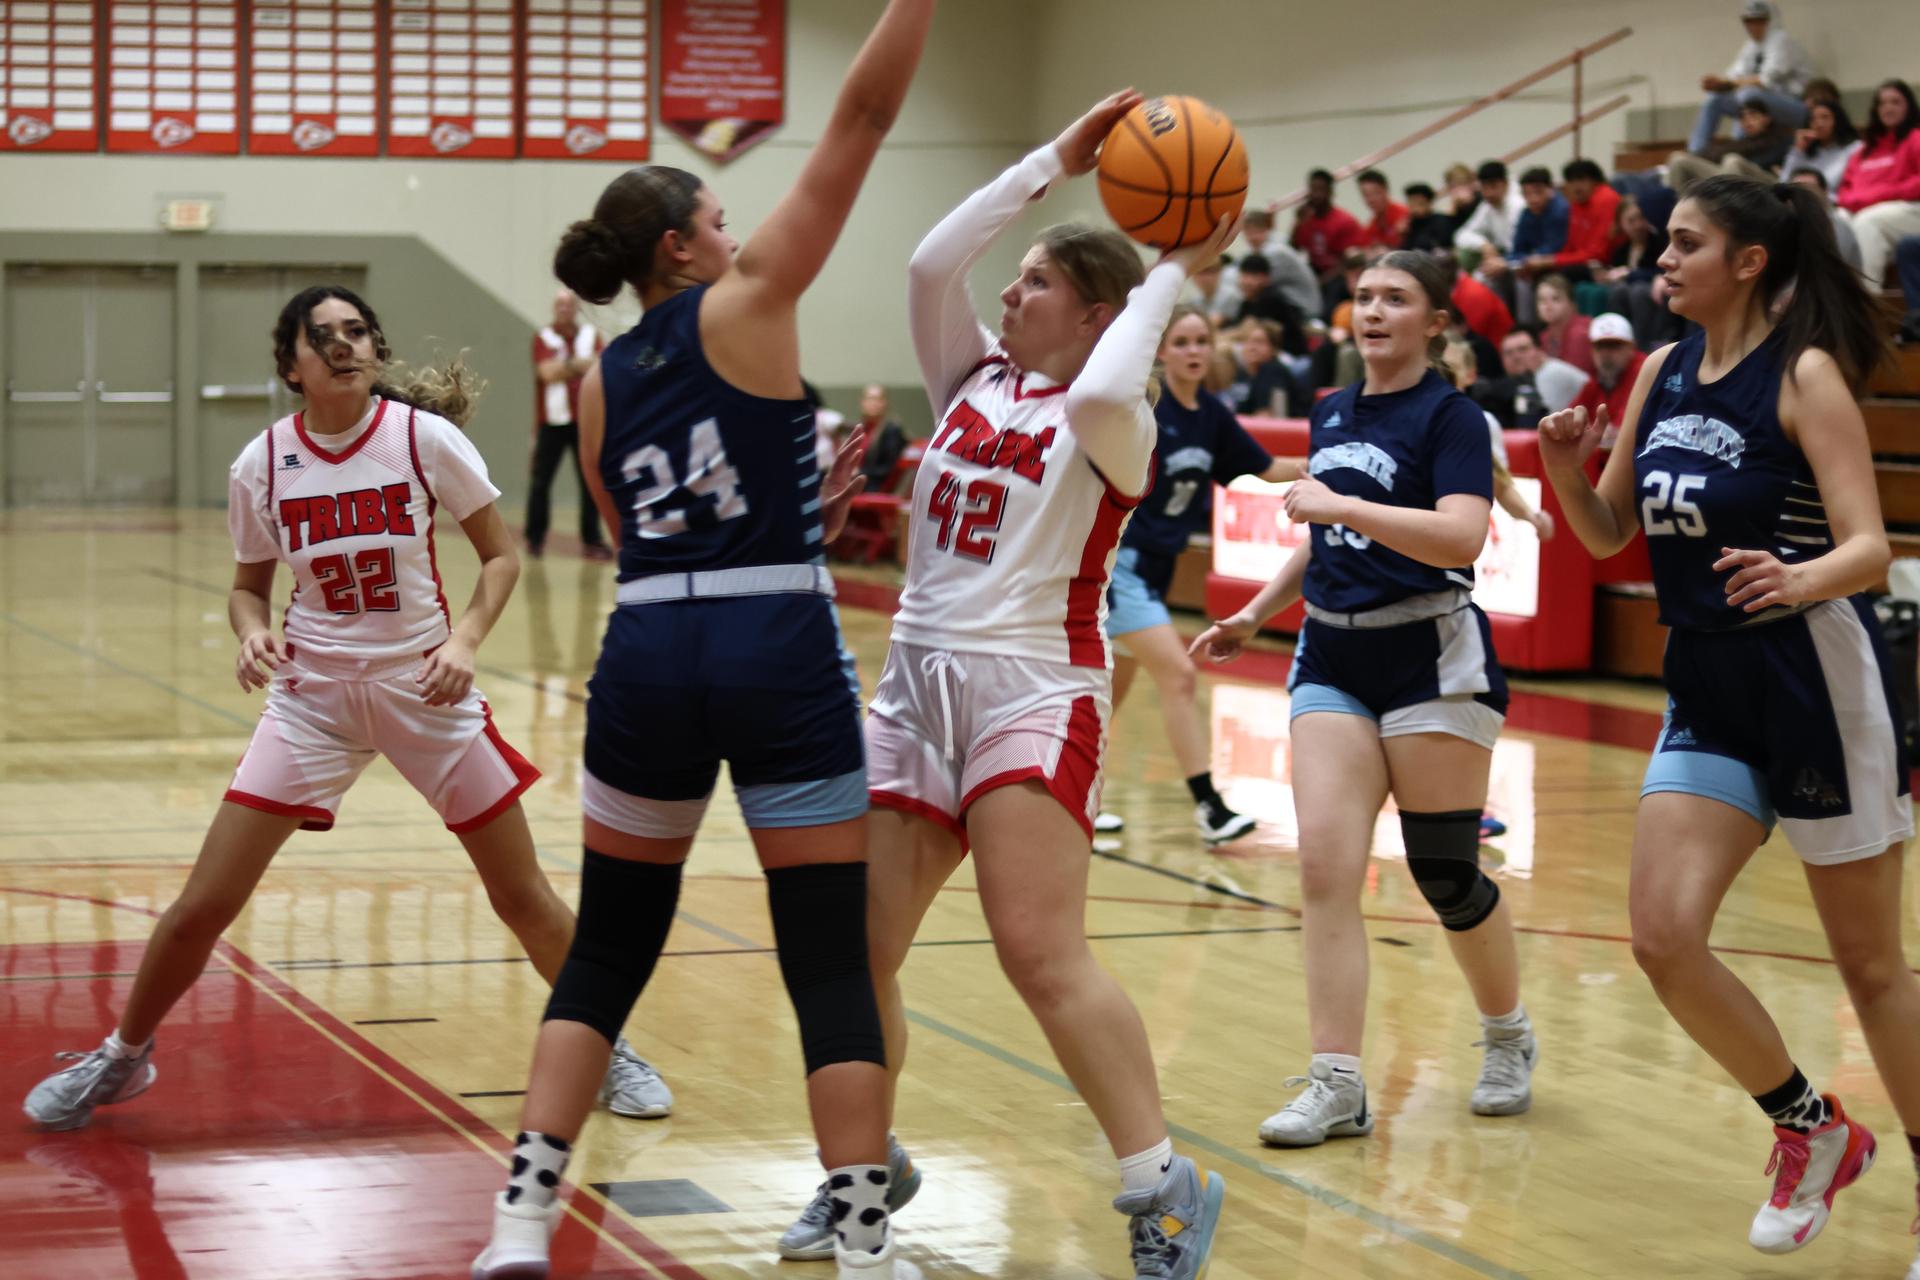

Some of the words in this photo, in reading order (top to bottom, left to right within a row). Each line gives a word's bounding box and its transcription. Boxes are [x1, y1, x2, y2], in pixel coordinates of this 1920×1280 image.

[620, 417, 749, 540] 24
[930, 398, 1056, 486] TRIBE
[279, 482, 416, 553] TRIBE
[927, 470, 1010, 565] 42
[1642, 470, 1708, 538] 25
[310, 547, 400, 615] 22
